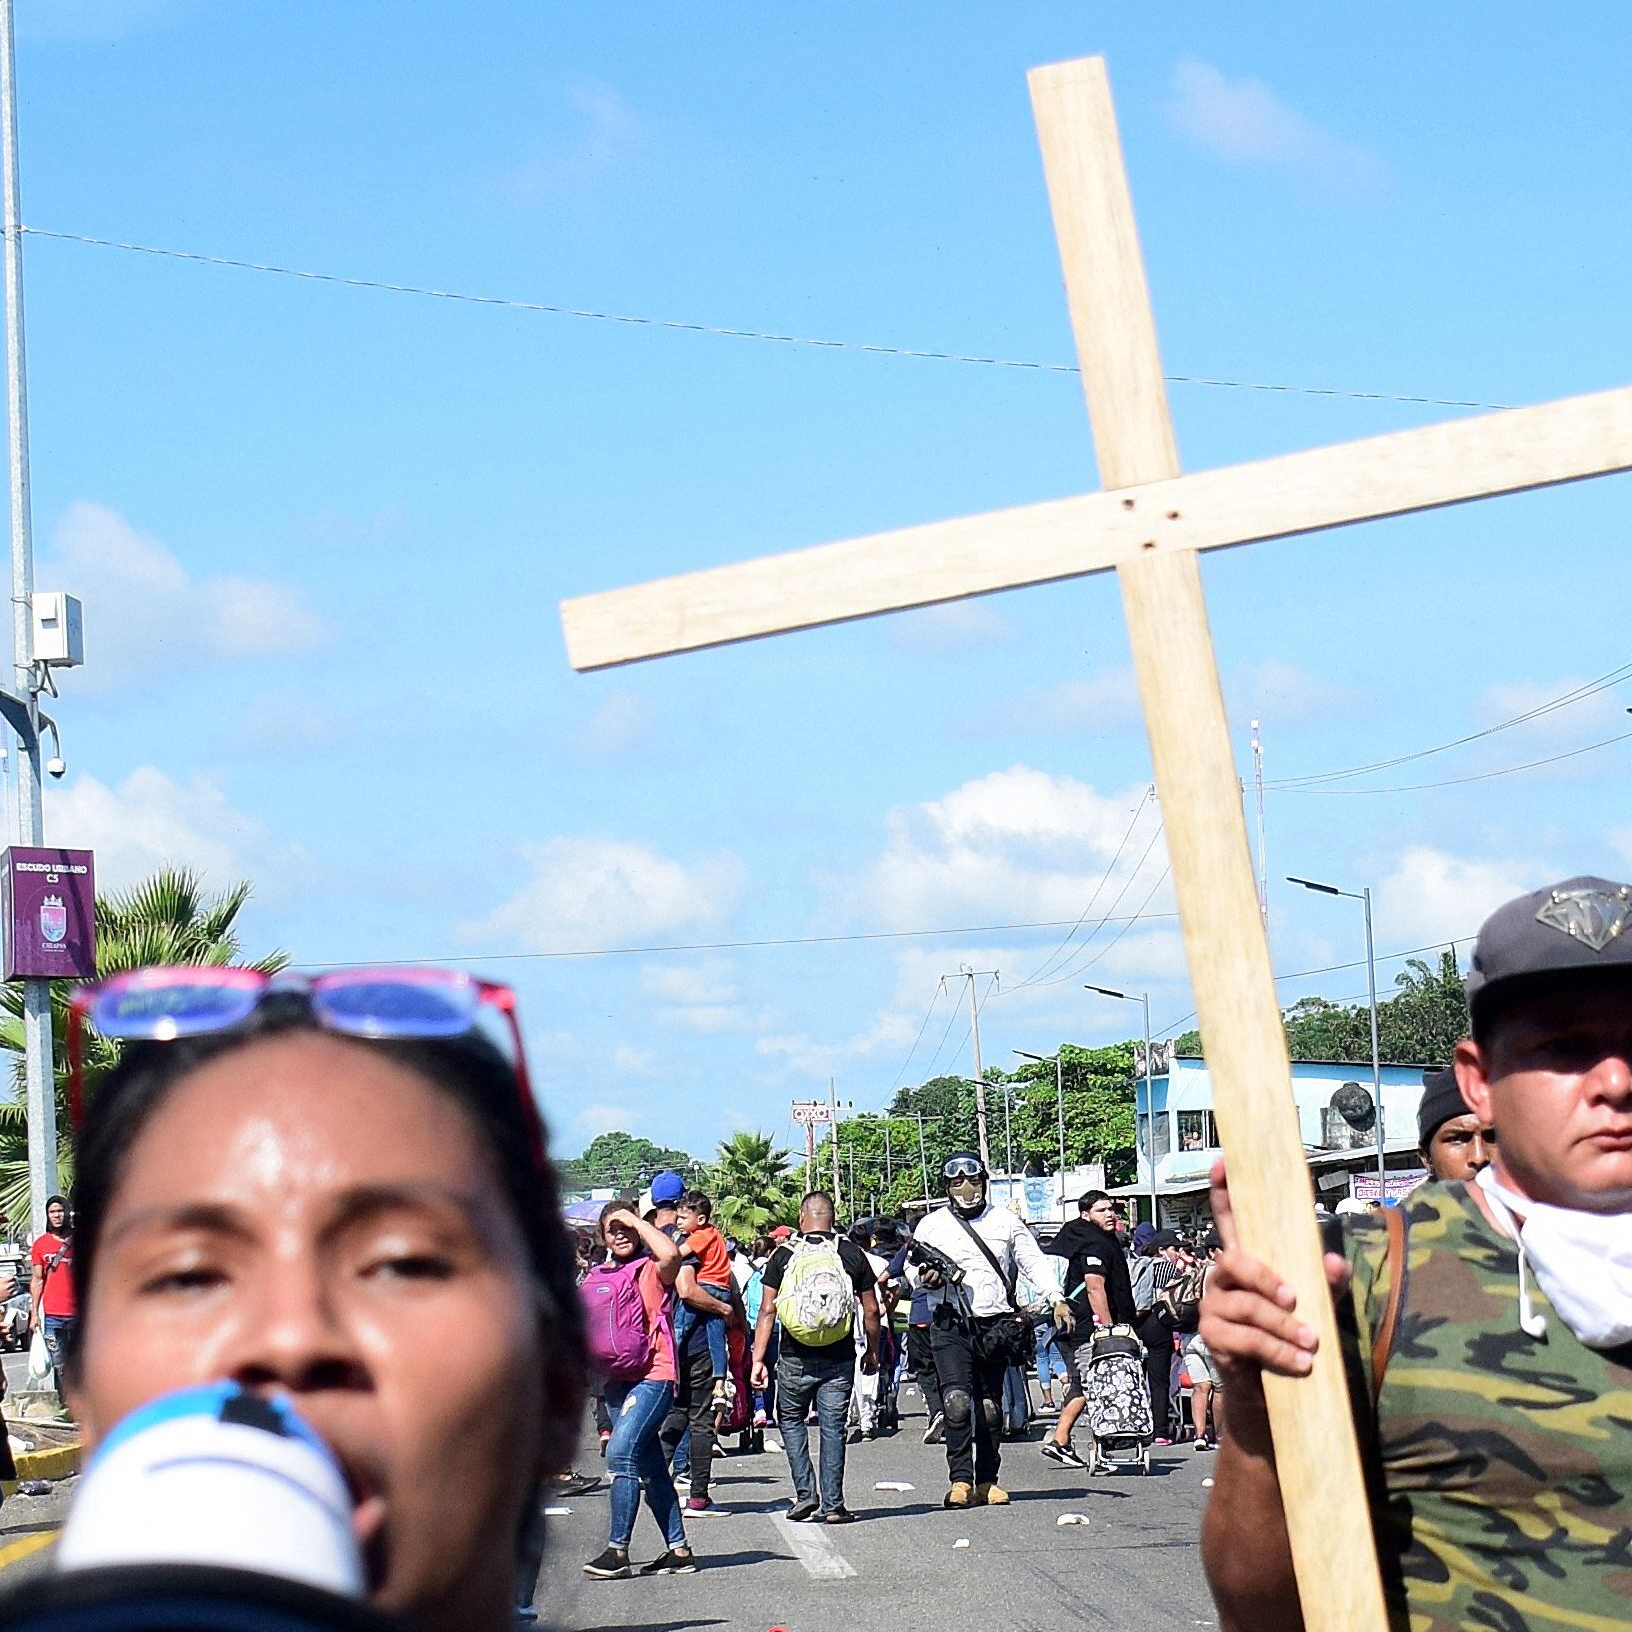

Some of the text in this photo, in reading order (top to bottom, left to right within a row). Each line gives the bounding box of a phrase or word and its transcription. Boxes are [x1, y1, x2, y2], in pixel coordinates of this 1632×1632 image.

[16, 863, 51, 872] ESCUDO
[52, 864, 88, 874] URBANO
[46, 874, 59, 883] C5
